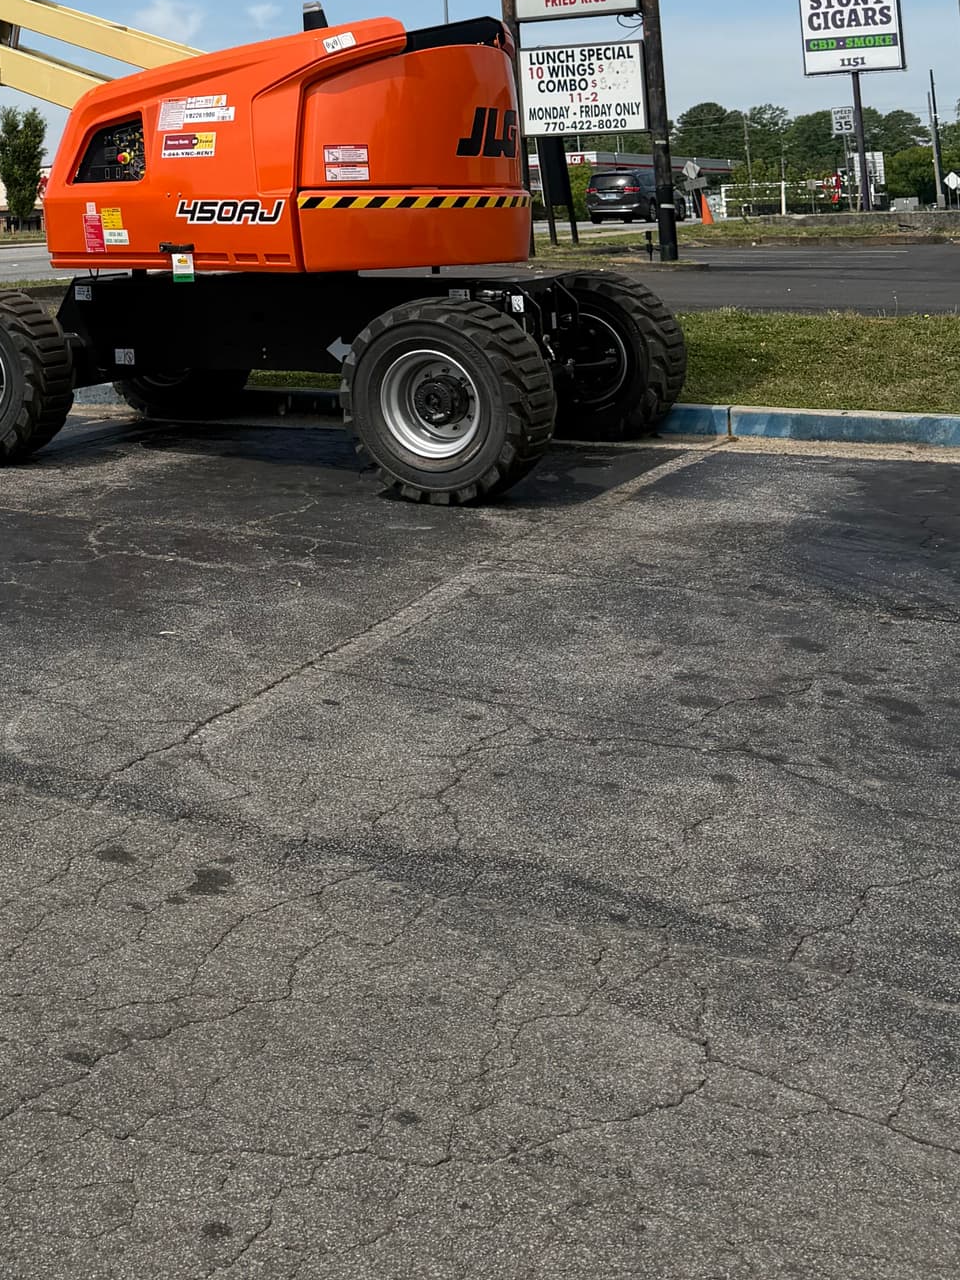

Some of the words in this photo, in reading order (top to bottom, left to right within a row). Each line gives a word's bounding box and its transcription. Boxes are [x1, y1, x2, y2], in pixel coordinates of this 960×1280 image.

[807, 5, 892, 31] CIGARS
[809, 39, 837, 50] CBD
[845, 35, 893, 48] SMOKE
[529, 49, 575, 66] LUNCH
[580, 46, 634, 62] SPECIAL
[840, 56, 866, 67] 1151
[529, 66, 544, 80] 10
[547, 63, 595, 78] WINGS
[537, 78, 588, 93] COMBO
[569, 91, 599, 103] 11-2
[529, 105, 570, 121] MONDAY
[580, 103, 612, 118] FRIDAY
[615, 101, 641, 116] ONLY
[456, 106, 517, 158] JLG
[544, 118, 627, 132] 770-422-8020
[835, 120, 852, 131] 35
[176, 199, 285, 224] 450AJ
